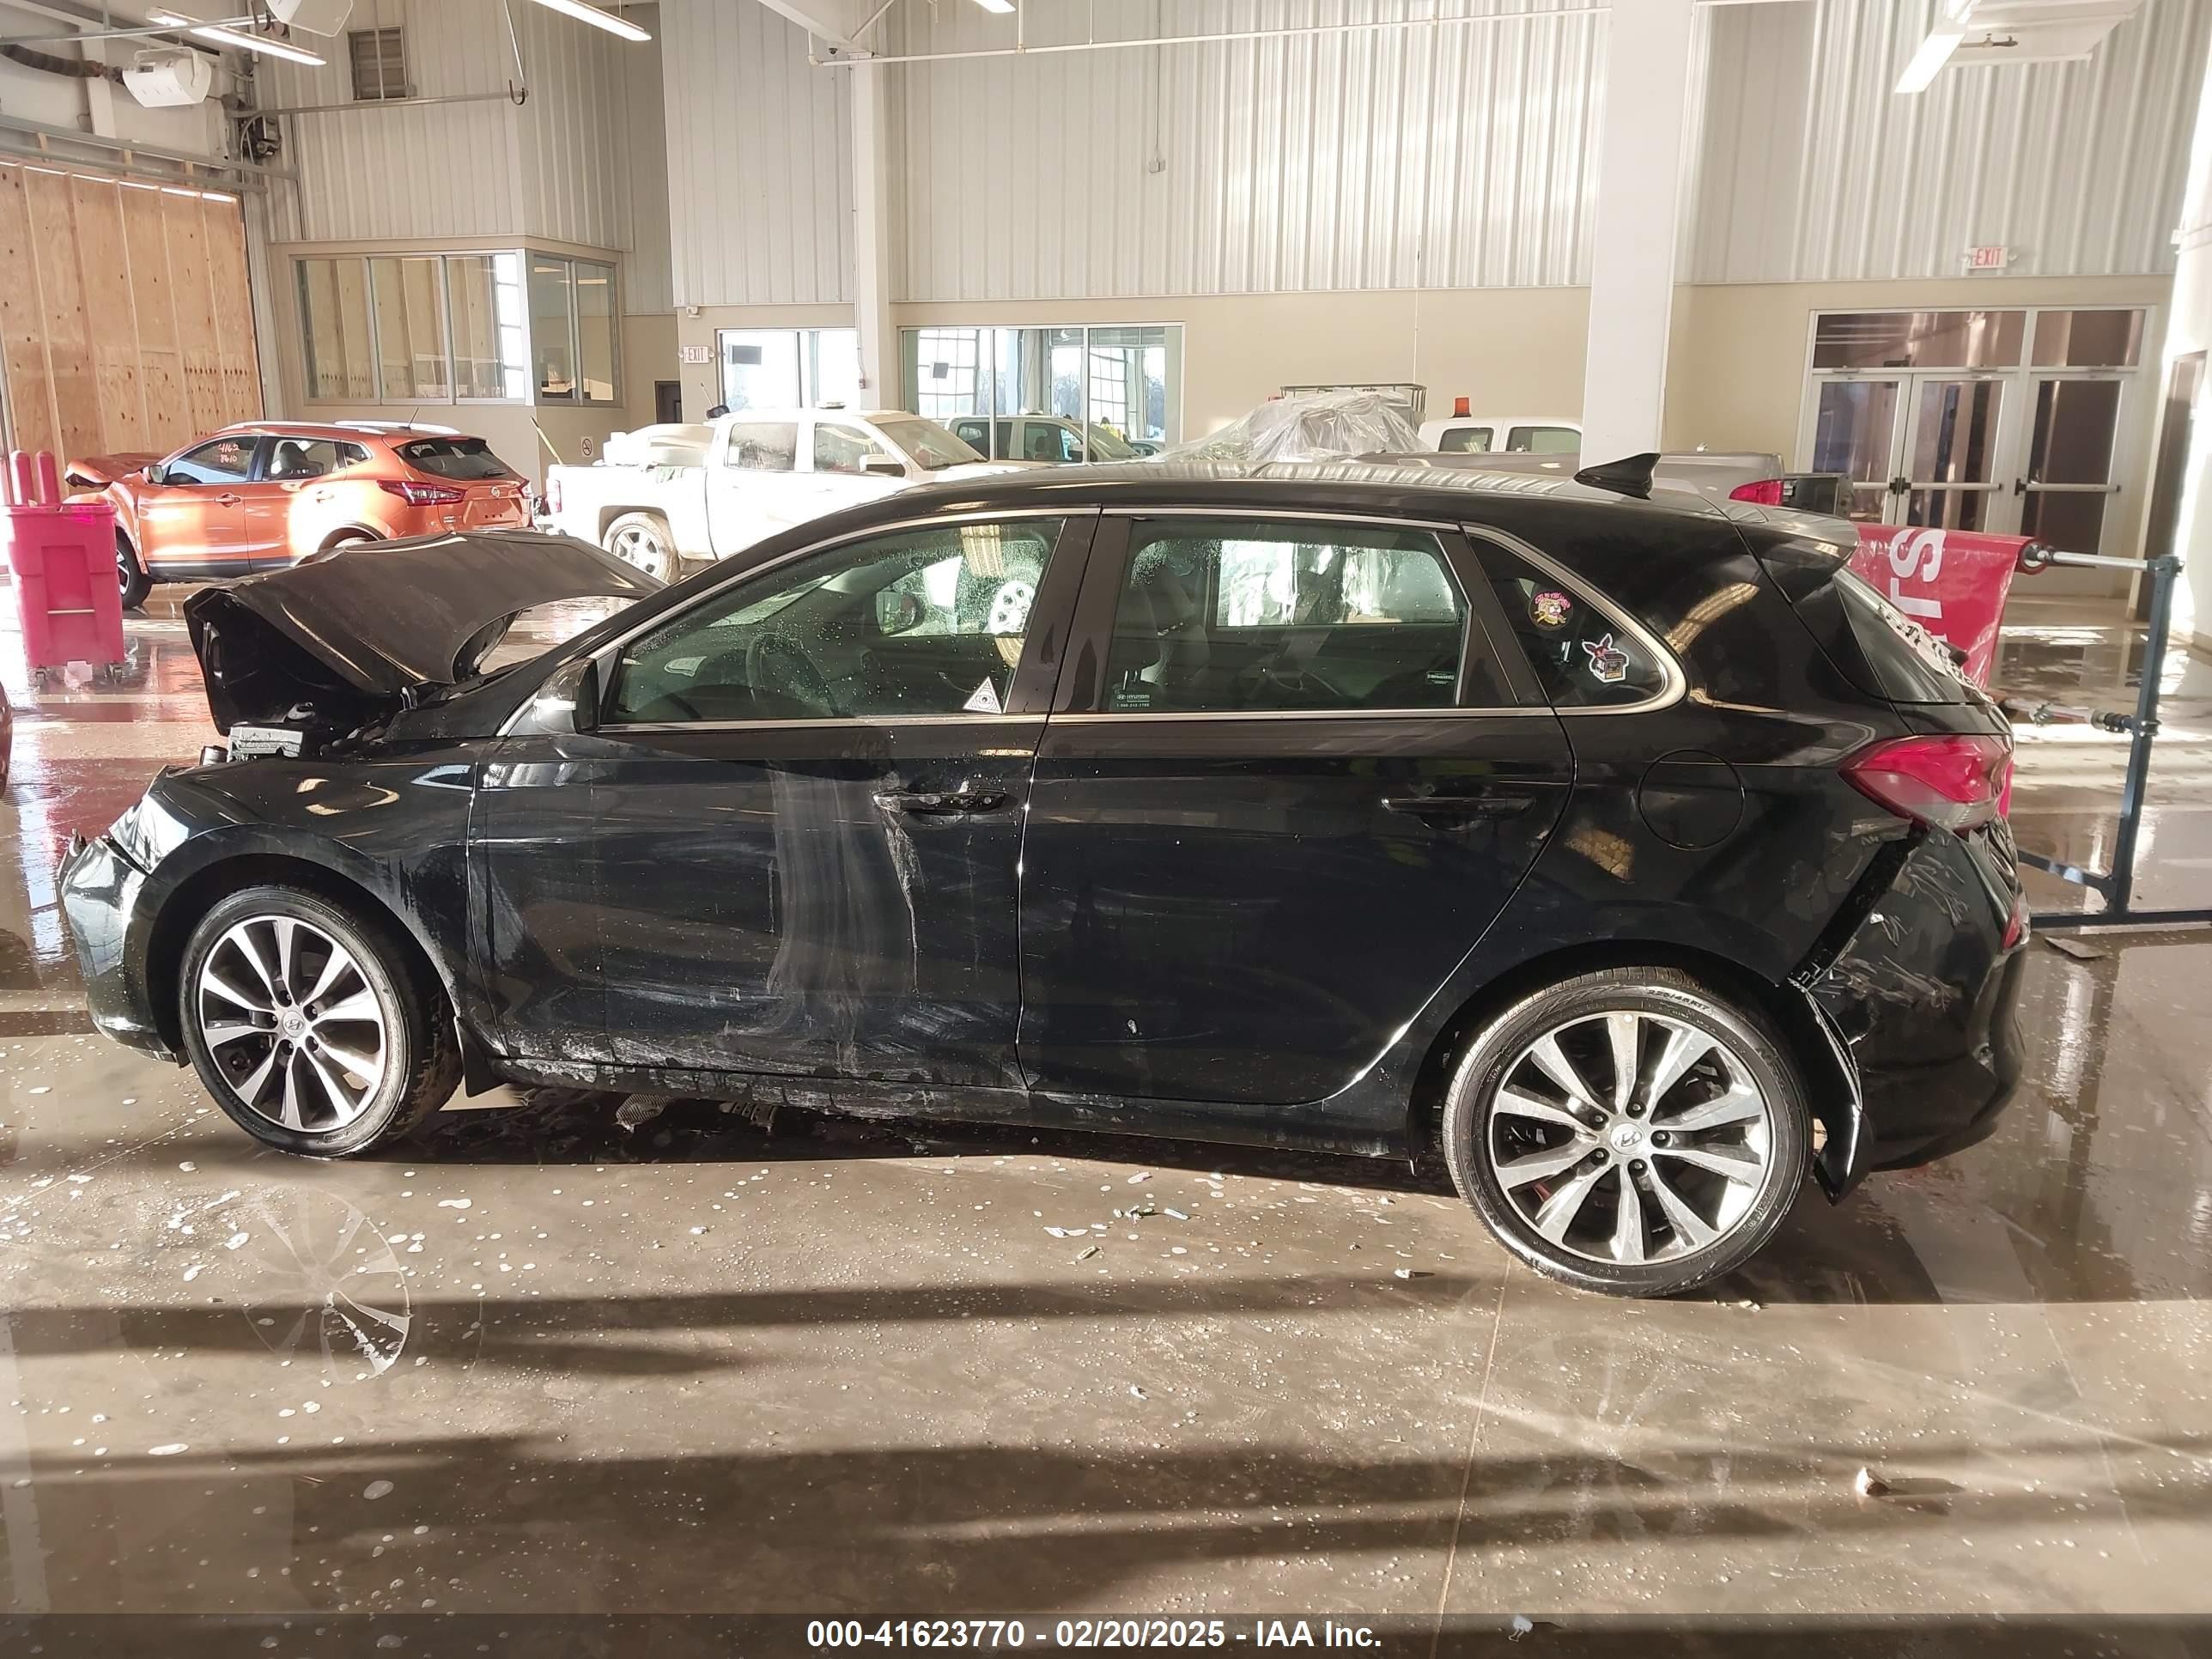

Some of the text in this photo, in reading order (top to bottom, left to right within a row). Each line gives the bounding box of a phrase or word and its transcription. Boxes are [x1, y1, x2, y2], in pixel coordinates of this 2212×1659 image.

[1976, 247, 2002, 266] EXIT
[688, 347, 704, 362] EXIT
[218, 443, 240, 453] 4162
[1890, 529, 1948, 642] TS
